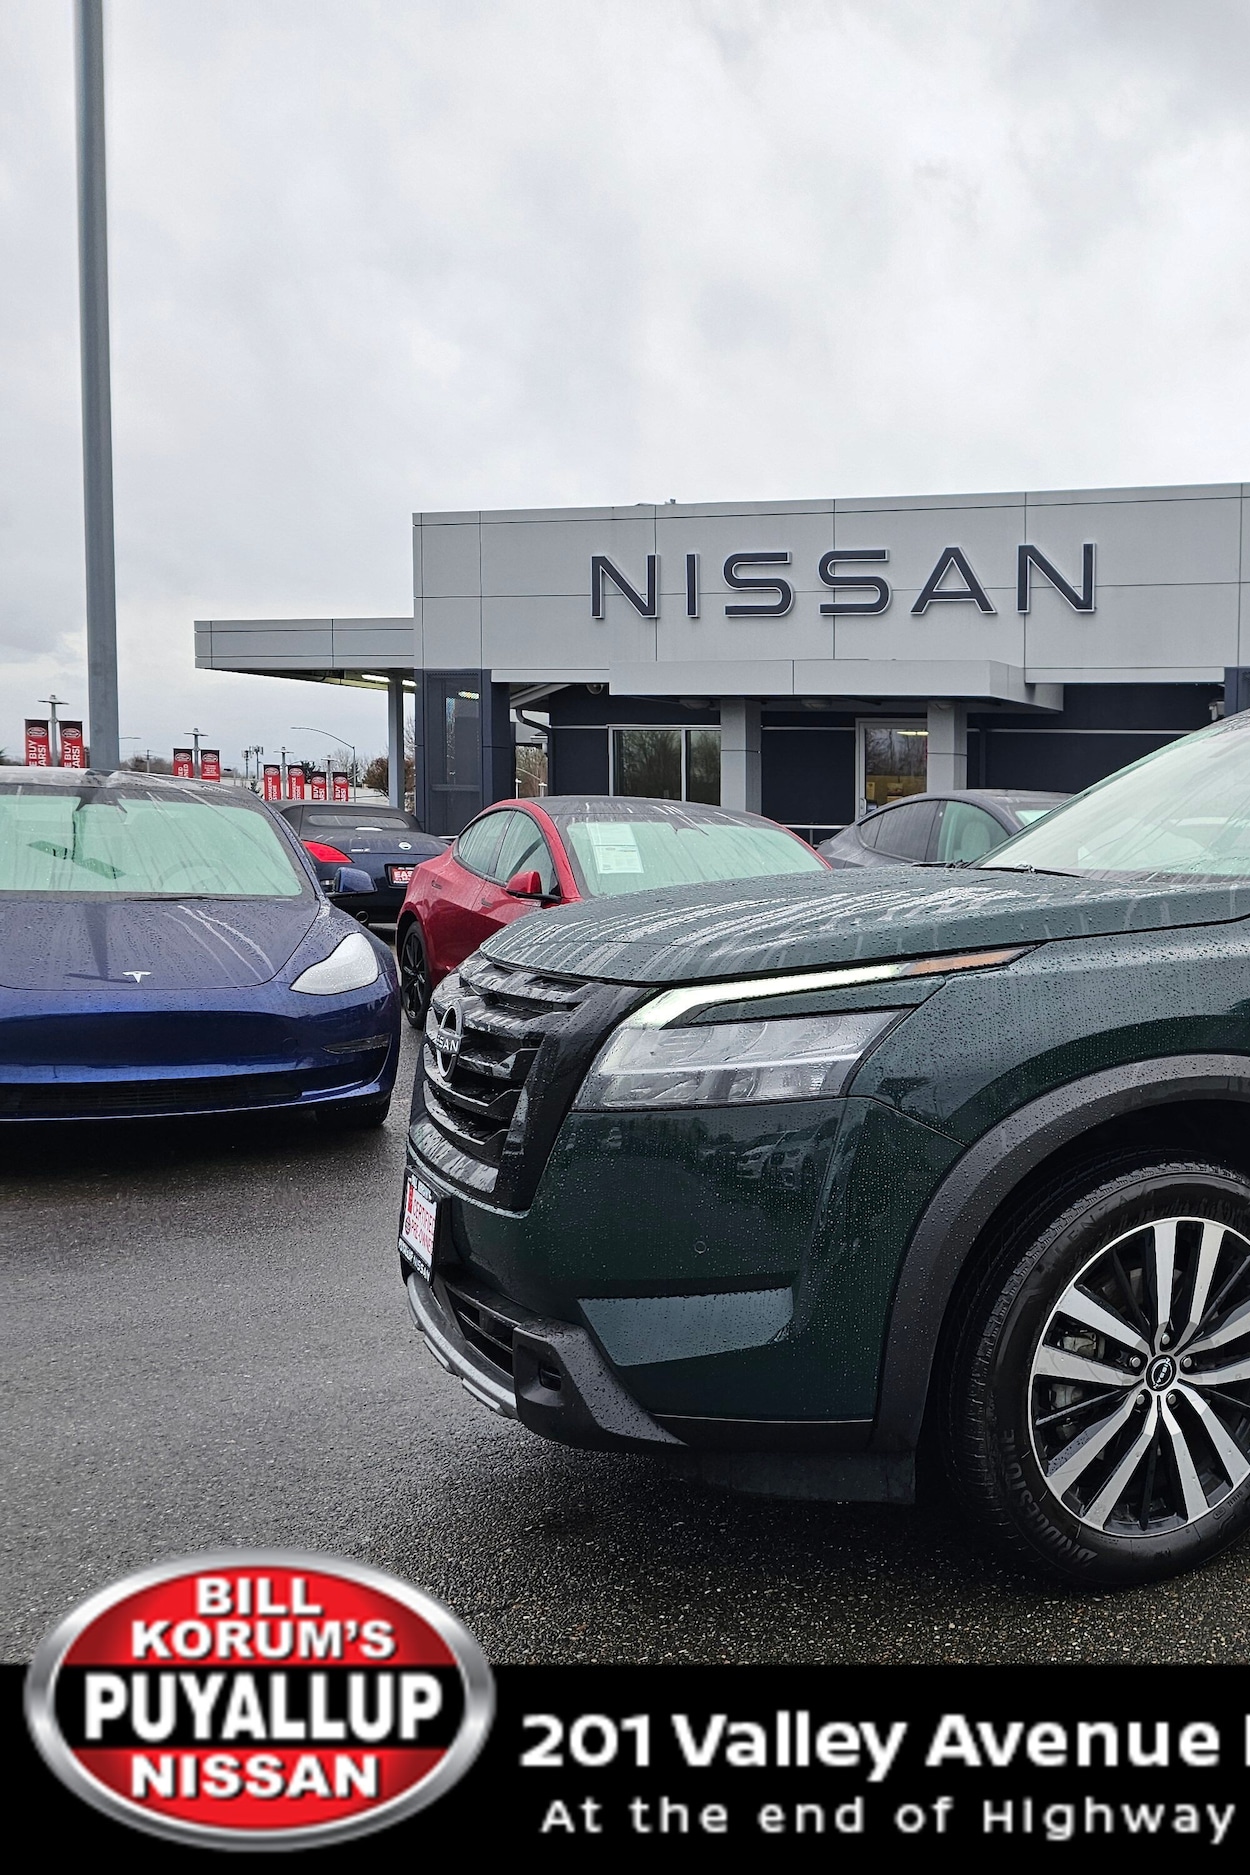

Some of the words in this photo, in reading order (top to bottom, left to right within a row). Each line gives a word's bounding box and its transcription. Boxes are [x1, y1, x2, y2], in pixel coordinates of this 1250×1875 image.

[591, 543, 1097, 618] NISSAN
[38, 745, 46, 766] ARS!
[72, 746, 80, 768] ARS!
